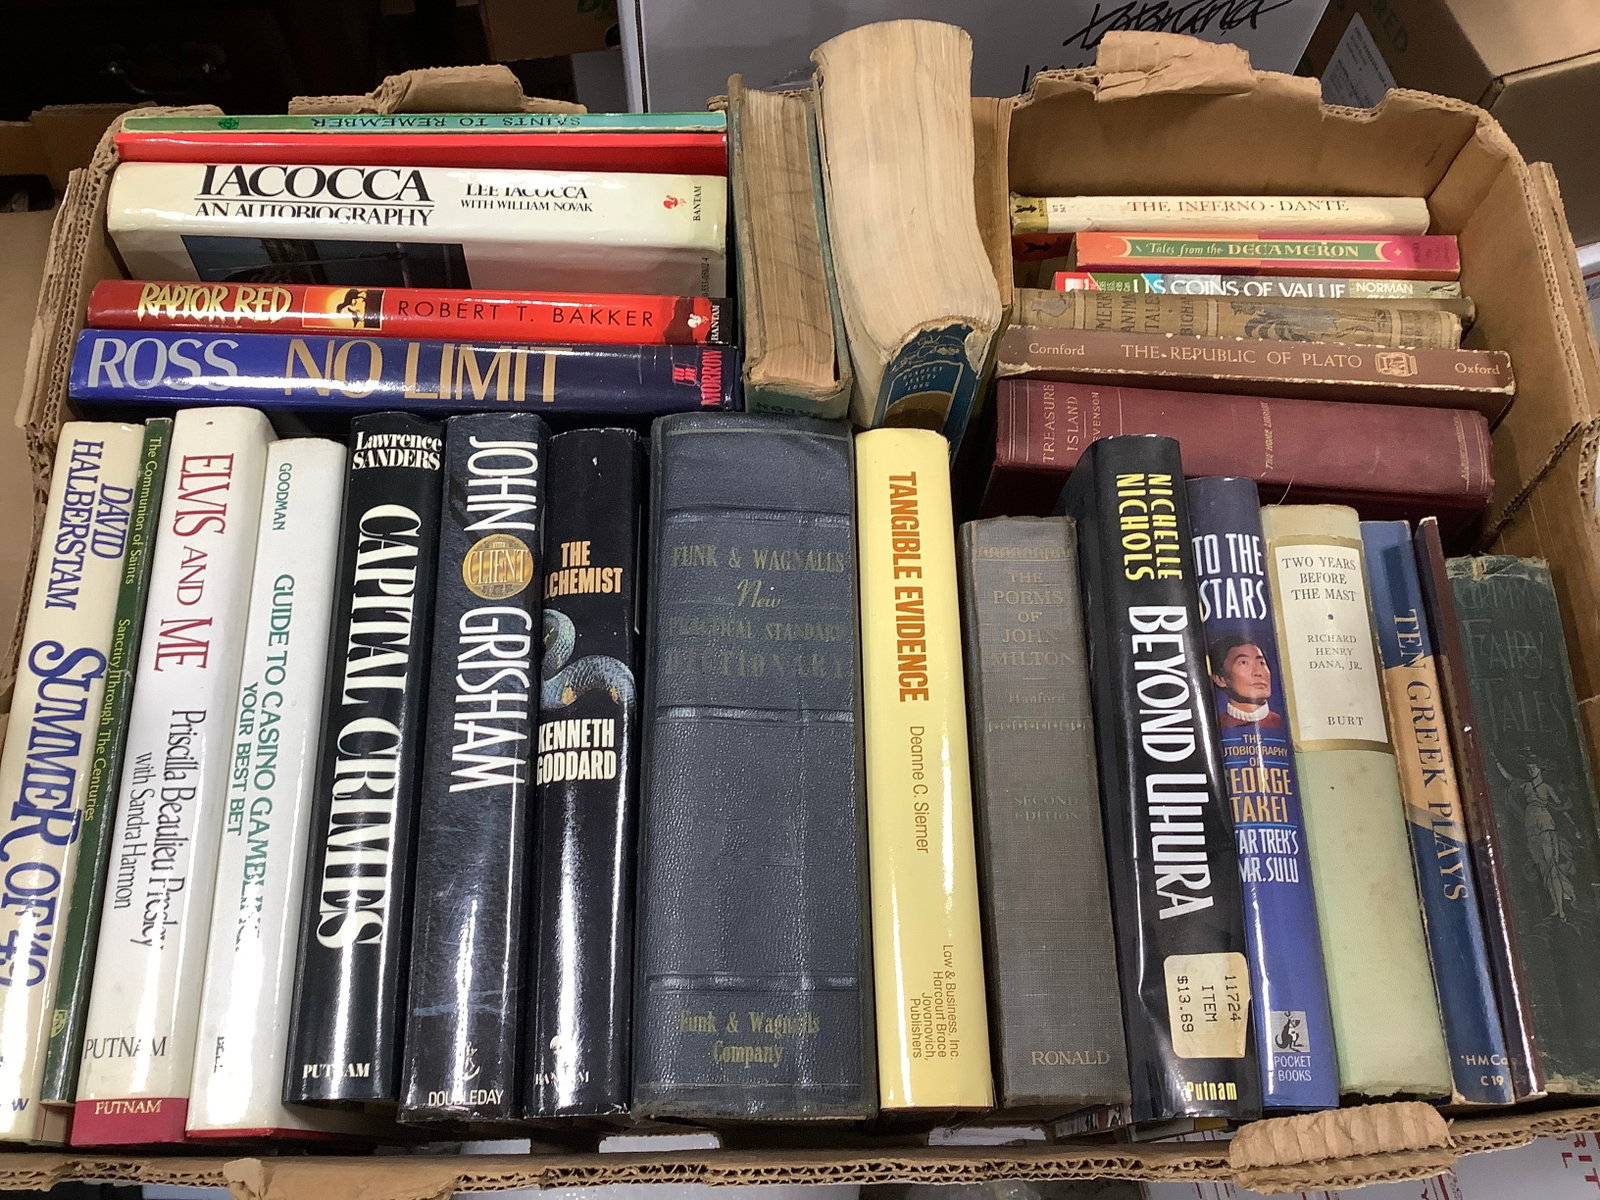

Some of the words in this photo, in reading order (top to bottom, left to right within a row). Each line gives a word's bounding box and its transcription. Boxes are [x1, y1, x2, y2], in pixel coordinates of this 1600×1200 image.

[311, 117, 447, 128] REMEMBER
[460, 117, 488, 127] TO
[502, 116, 581, 127] SAINTS
[198, 164, 433, 201] IACOCCA
[195, 202, 230, 217] AN
[235, 203, 435, 227] AUTOBIOGRAPHY
[461, 199, 494, 210] WITH
[497, 200, 550, 211] WILLIAM
[553, 201, 593, 212] NOVAK
[693, 185, 702, 221] BANTAM
[1127, 201, 1171, 212] THE
[1178, 200, 1265, 212] INFERNO
[1279, 200, 1349, 212] DANTE
[1146, 242, 1175, 255] Tales
[1178, 244, 1203, 260] from
[1207, 243, 1222, 255] the
[1228, 243, 1360, 257] DECAMERON
[137, 283, 229, 322] RAPTOR
[233, 287, 292, 324] RED
[1171, 280, 1239, 296] COINS
[1243, 280, 1273, 297] OF
[1356, 282, 1414, 295] NORMAN
[398, 300, 500, 320] ROBERT
[516, 305, 534, 322] T.
[553, 307, 653, 326] BAKKER
[711, 305, 720, 342] BANTAM
[86, 338, 239, 390] ROSS
[284, 338, 384, 398] NO
[404, 340, 574, 403] LIMIT
[1028, 342, 1086, 356] Cornford
[1121, 344, 1160, 359] THE
[1170, 346, 1257, 364] REPUBLIC
[1267, 351, 1292, 366] OF
[1302, 352, 1363, 369] PLATO
[1454, 362, 1501, 376] Oxford
[701, 350, 722, 406] MORROW
[356, 430, 442, 452] Lawrence
[1043, 384, 1055, 463] TREASURE
[1066, 396, 1079, 451] ISLAND
[148, 436, 163, 457] The
[352, 450, 440, 471] SANDERS
[133, 457, 160, 539] Communion
[172, 453, 235, 537] ELVIS
[273, 462, 292, 530] GOODMAN
[463, 435, 538, 531] JOHN
[45, 439, 104, 610] HALBERSTAM
[90, 482, 134, 559] DAVID
[889, 471, 922, 580] TANGIBLE
[1116, 473, 1155, 581] NICHOLS
[1147, 473, 1183, 580] NICHELLE
[125, 547, 142, 585] Saints
[468, 549, 527, 584] CLIENT
[561, 541, 590, 567] THE
[673, 545, 717, 567] FUNK
[729, 548, 741, 568] &
[1192, 533, 1220, 576] TO
[1225, 533, 1264, 577] THE
[1282, 556, 1315, 570] TWO
[1318, 557, 1357, 570] YEARS
[176, 546, 208, 606] AND
[544, 568, 623, 598] LCHEMIST
[737, 580, 781, 608] New
[1008, 572, 1043, 583] THE
[1299, 572, 1347, 586] BEFORE
[268, 573, 295, 647] GUIDE
[342, 503, 421, 706] CAPITAL
[993, 590, 1064, 605] POEMS
[1200, 578, 1268, 622] STARS
[1291, 588, 1321, 601] THE
[1324, 589, 1357, 602] MAST
[1018, 611, 1042, 623] OF
[111, 619, 131, 671] Sanctity
[153, 616, 213, 672] ME
[895, 586, 929, 703] EVIDENCE
[1306, 633, 1357, 645] RICHARD
[1315, 646, 1354, 657] HENRY
[1393, 607, 1428, 671] TEN
[264, 654, 287, 686] TO
[991, 651, 1075, 666] MILTON
[1308, 660, 1345, 672] DANA,
[1348, 660, 1362, 671] JR.
[99, 671, 122, 727] Through
[449, 605, 533, 793] GRISHAM
[1128, 605, 1197, 762] BEYOND
[238, 681, 258, 737] YOUR
[1327, 715, 1364, 726] BURT
[0, 639, 107, 862] SUMMER
[98, 728, 112, 750] The
[163, 709, 207, 781] Priscilla
[254, 690, 283, 791] CASINO
[538, 719, 614, 754] KENNETH
[1242, 734, 1262, 744] THE
[1406, 679, 1447, 788] GREEK
[132, 752, 152, 785] with
[231, 741, 254, 791] BEST
[537, 750, 616, 786] GODDARD
[910, 726, 925, 781] Deanne
[84, 750, 107, 822] Centuries
[912, 784, 928, 799] C.
[1230, 767, 1293, 795] EORGE
[122, 788, 154, 842] Sandra
[227, 800, 246, 836] BET
[1230, 796, 1289, 823] TAKEI
[149, 786, 198, 871] Beaulieu
[316, 716, 402, 949] CRIMES
[914, 802, 929, 854] Siemer
[1259, 829, 1299, 855] TREK'S
[1145, 773, 1214, 920] UHURA
[1427, 801, 1469, 900] PLAYS
[113, 843, 147, 910] Harmon
[1240, 857, 1266, 882] MR.
[1266, 856, 1299, 883] SULU
[943, 944, 954, 968] Law
[945, 970, 955, 979] &
[933, 971, 946, 1022] Harcourt
[945, 980, 958, 1037] Business,
[1176, 976, 1194, 1033] $13.69
[1201, 985, 1217, 1023] ITEM
[1224, 975, 1242, 1022] 11724
[679, 1010, 717, 1033] Funk
[727, 1012, 738, 1033] &
[910, 998, 922, 1058] Publishers
[922, 992, 936, 1061] Jovanovich,
[713, 1041, 783, 1068] Company
[936, 1024, 946, 1058] Brace
[950, 1040, 959, 1060] Inc.
[1031, 1050, 1110, 1066] RONALD
[1273, 1055, 1312, 1069] POCKET
[1278, 1069, 1312, 1082] BOOKS
[95, 1099, 162, 1115] PUTNAM
[1185, 1080, 1238, 1101] Putnam
